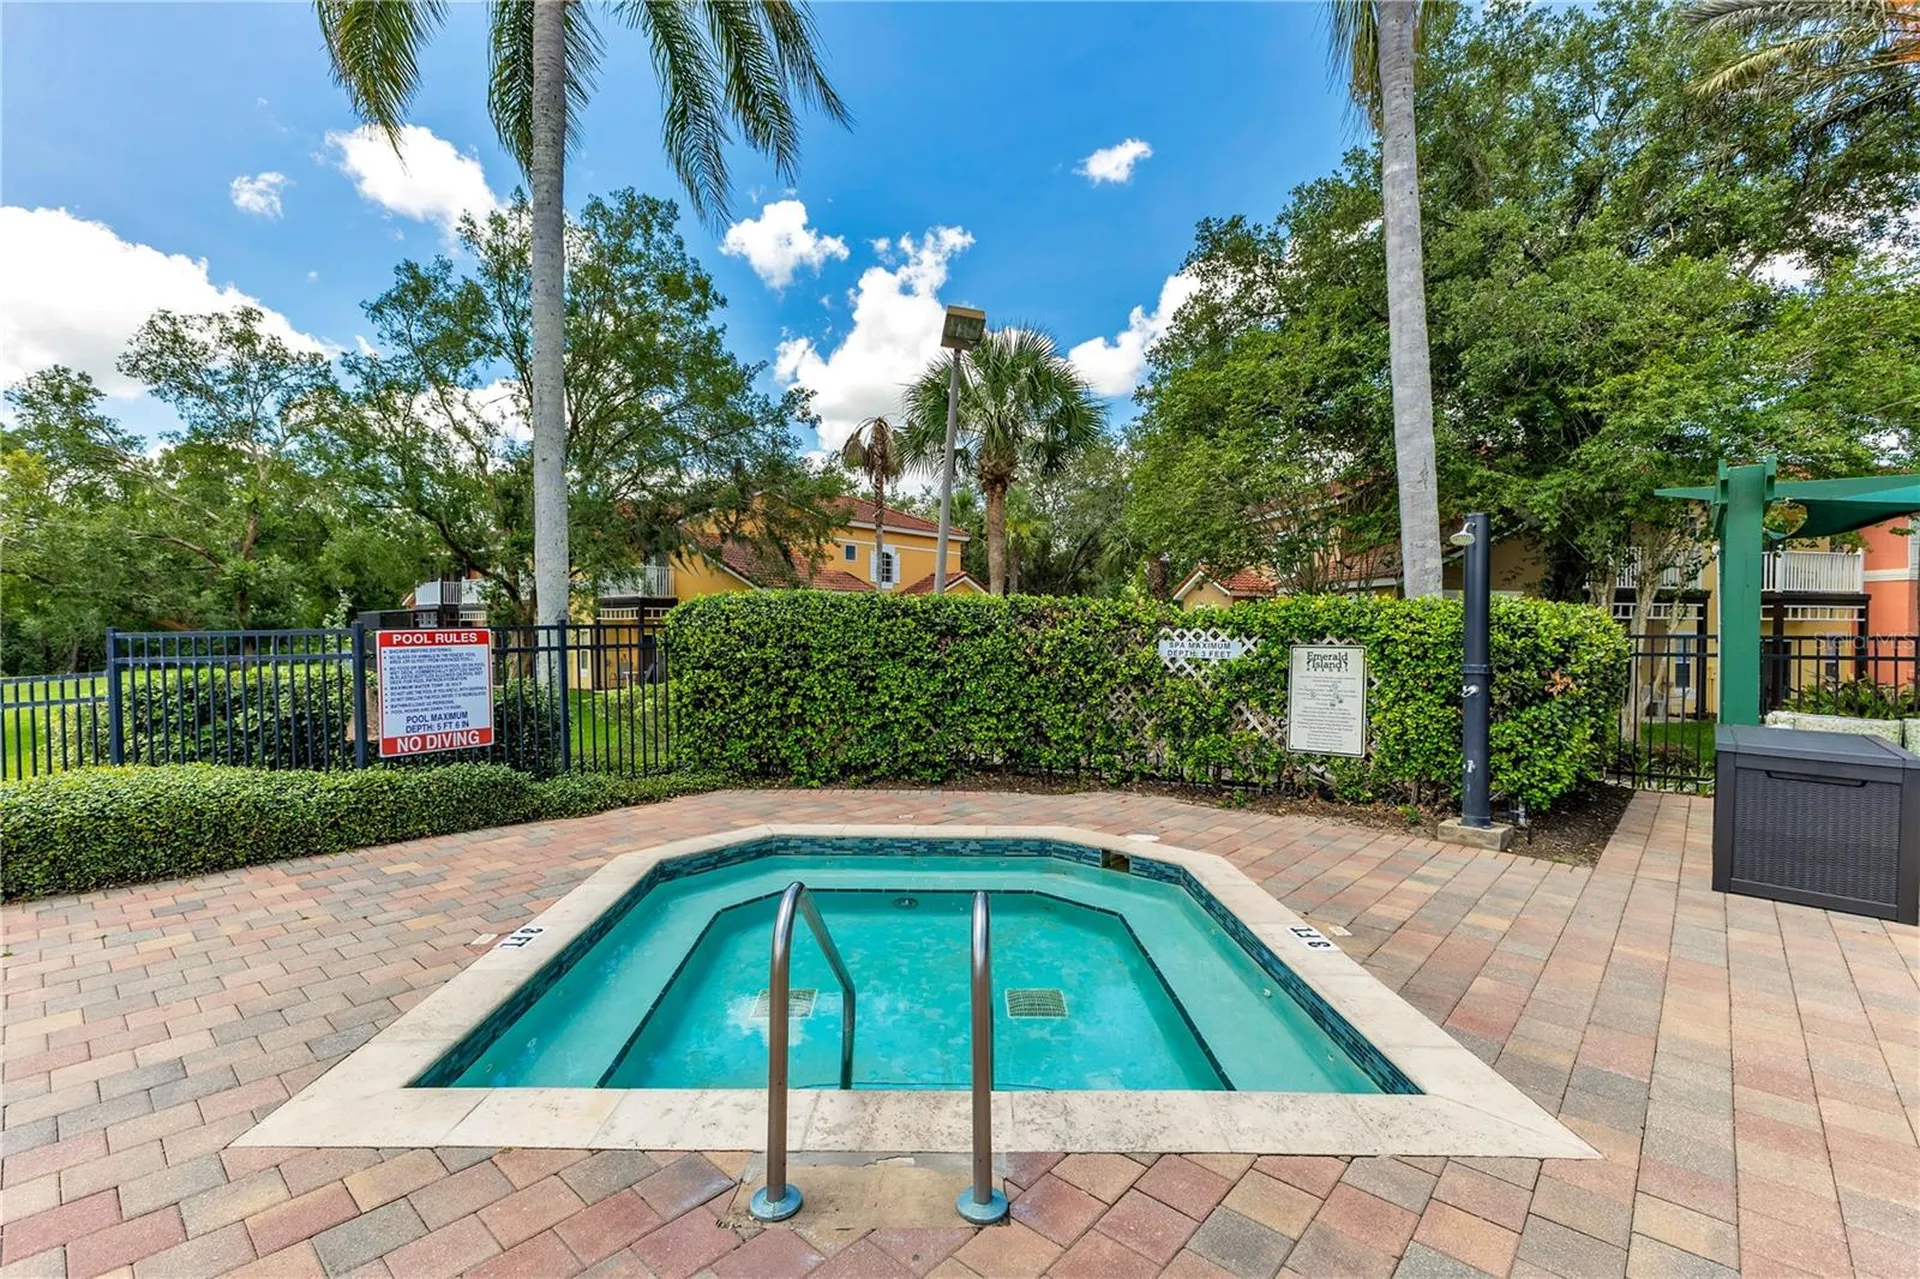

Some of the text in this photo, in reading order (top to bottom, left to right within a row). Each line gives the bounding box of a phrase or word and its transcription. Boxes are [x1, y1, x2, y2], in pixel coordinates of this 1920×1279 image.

[393, 632, 478, 644] POOL RULES
[1188, 641, 1231, 649] MAXIMUM
[1306, 651, 1348, 660] Emerald
[1312, 659, 1343, 669] Island
[406, 711, 468, 723] POOL MAXIMUM
[406, 723, 435, 733] DEPTH:
[443, 721, 452, 730] FT
[462, 720, 469, 728] IN
[396, 730, 480, 753] NO DIVING
[1290, 927, 1321, 938] FT
[500, 936, 534, 948] FT
